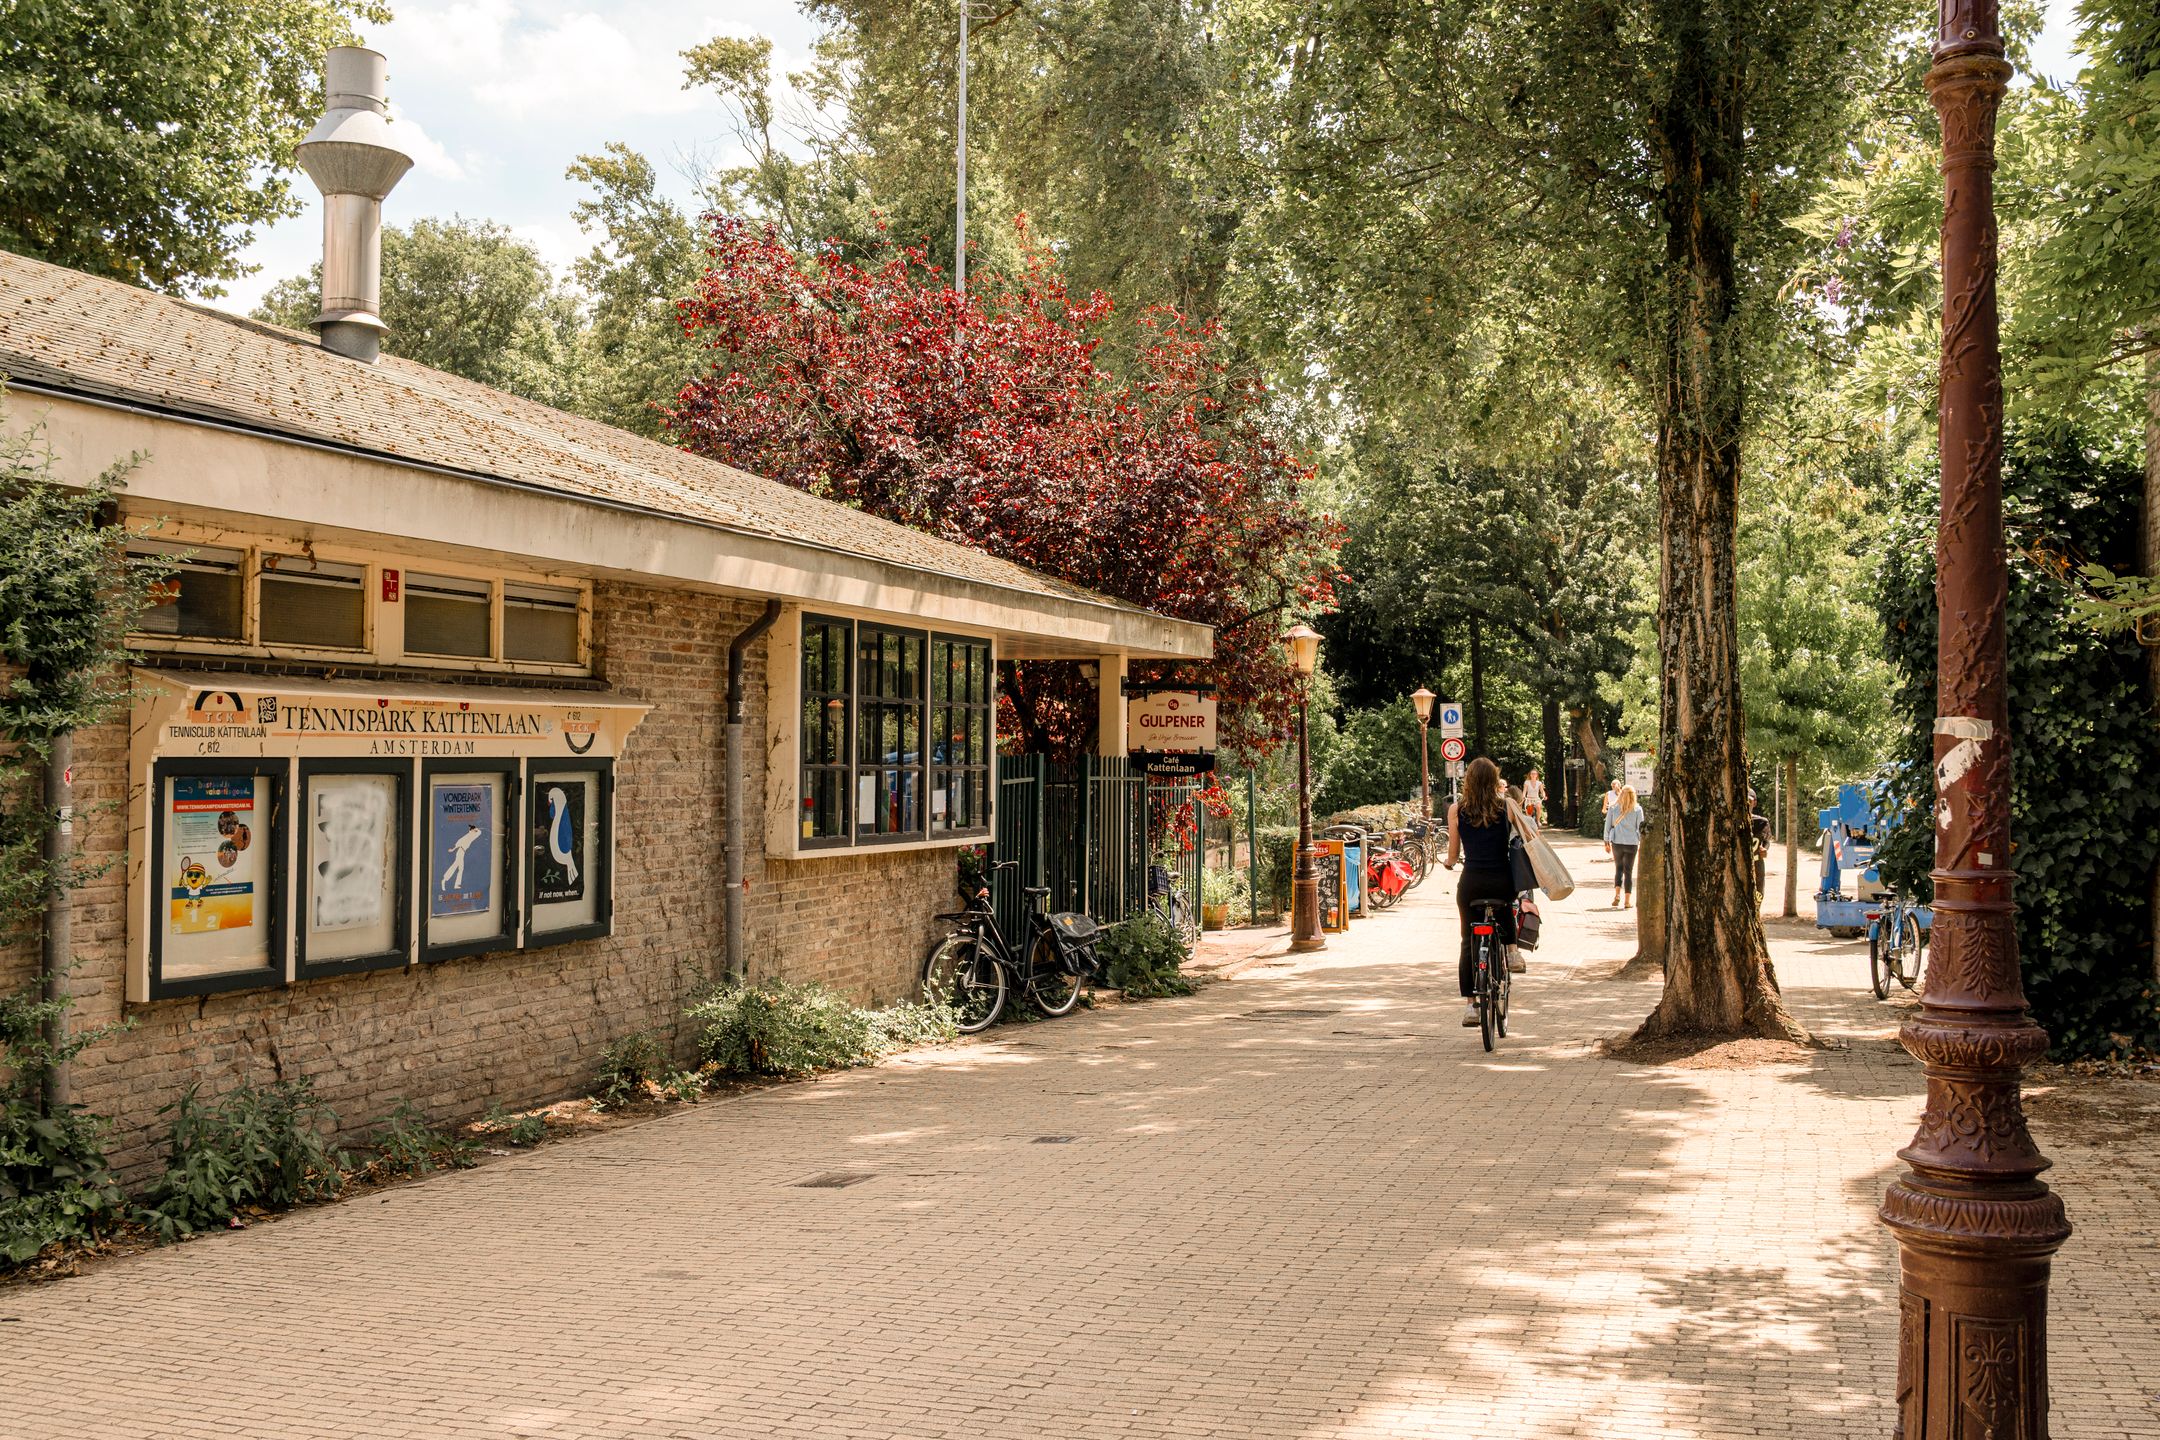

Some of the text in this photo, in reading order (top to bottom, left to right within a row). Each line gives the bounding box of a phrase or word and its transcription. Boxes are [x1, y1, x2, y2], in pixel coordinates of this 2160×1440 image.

[205, 712, 235, 723] TCK
[281, 705, 417, 733] TENNISPARK
[421, 710, 541, 735] KATTENLAAN
[1139, 713, 1205, 728] GULPENER
[169, 726, 267, 738] TENNISCLUB KATTENLAAN
[369, 739, 475, 755] AMSTERDAM
[1163, 756, 1180, 764] Café
[1147, 763, 1195, 773] Kattenlaan
[443, 792, 482, 803] VONDELPARK
[442, 803, 481, 813] WINTERTENNIS
[544, 890, 552, 899] not
